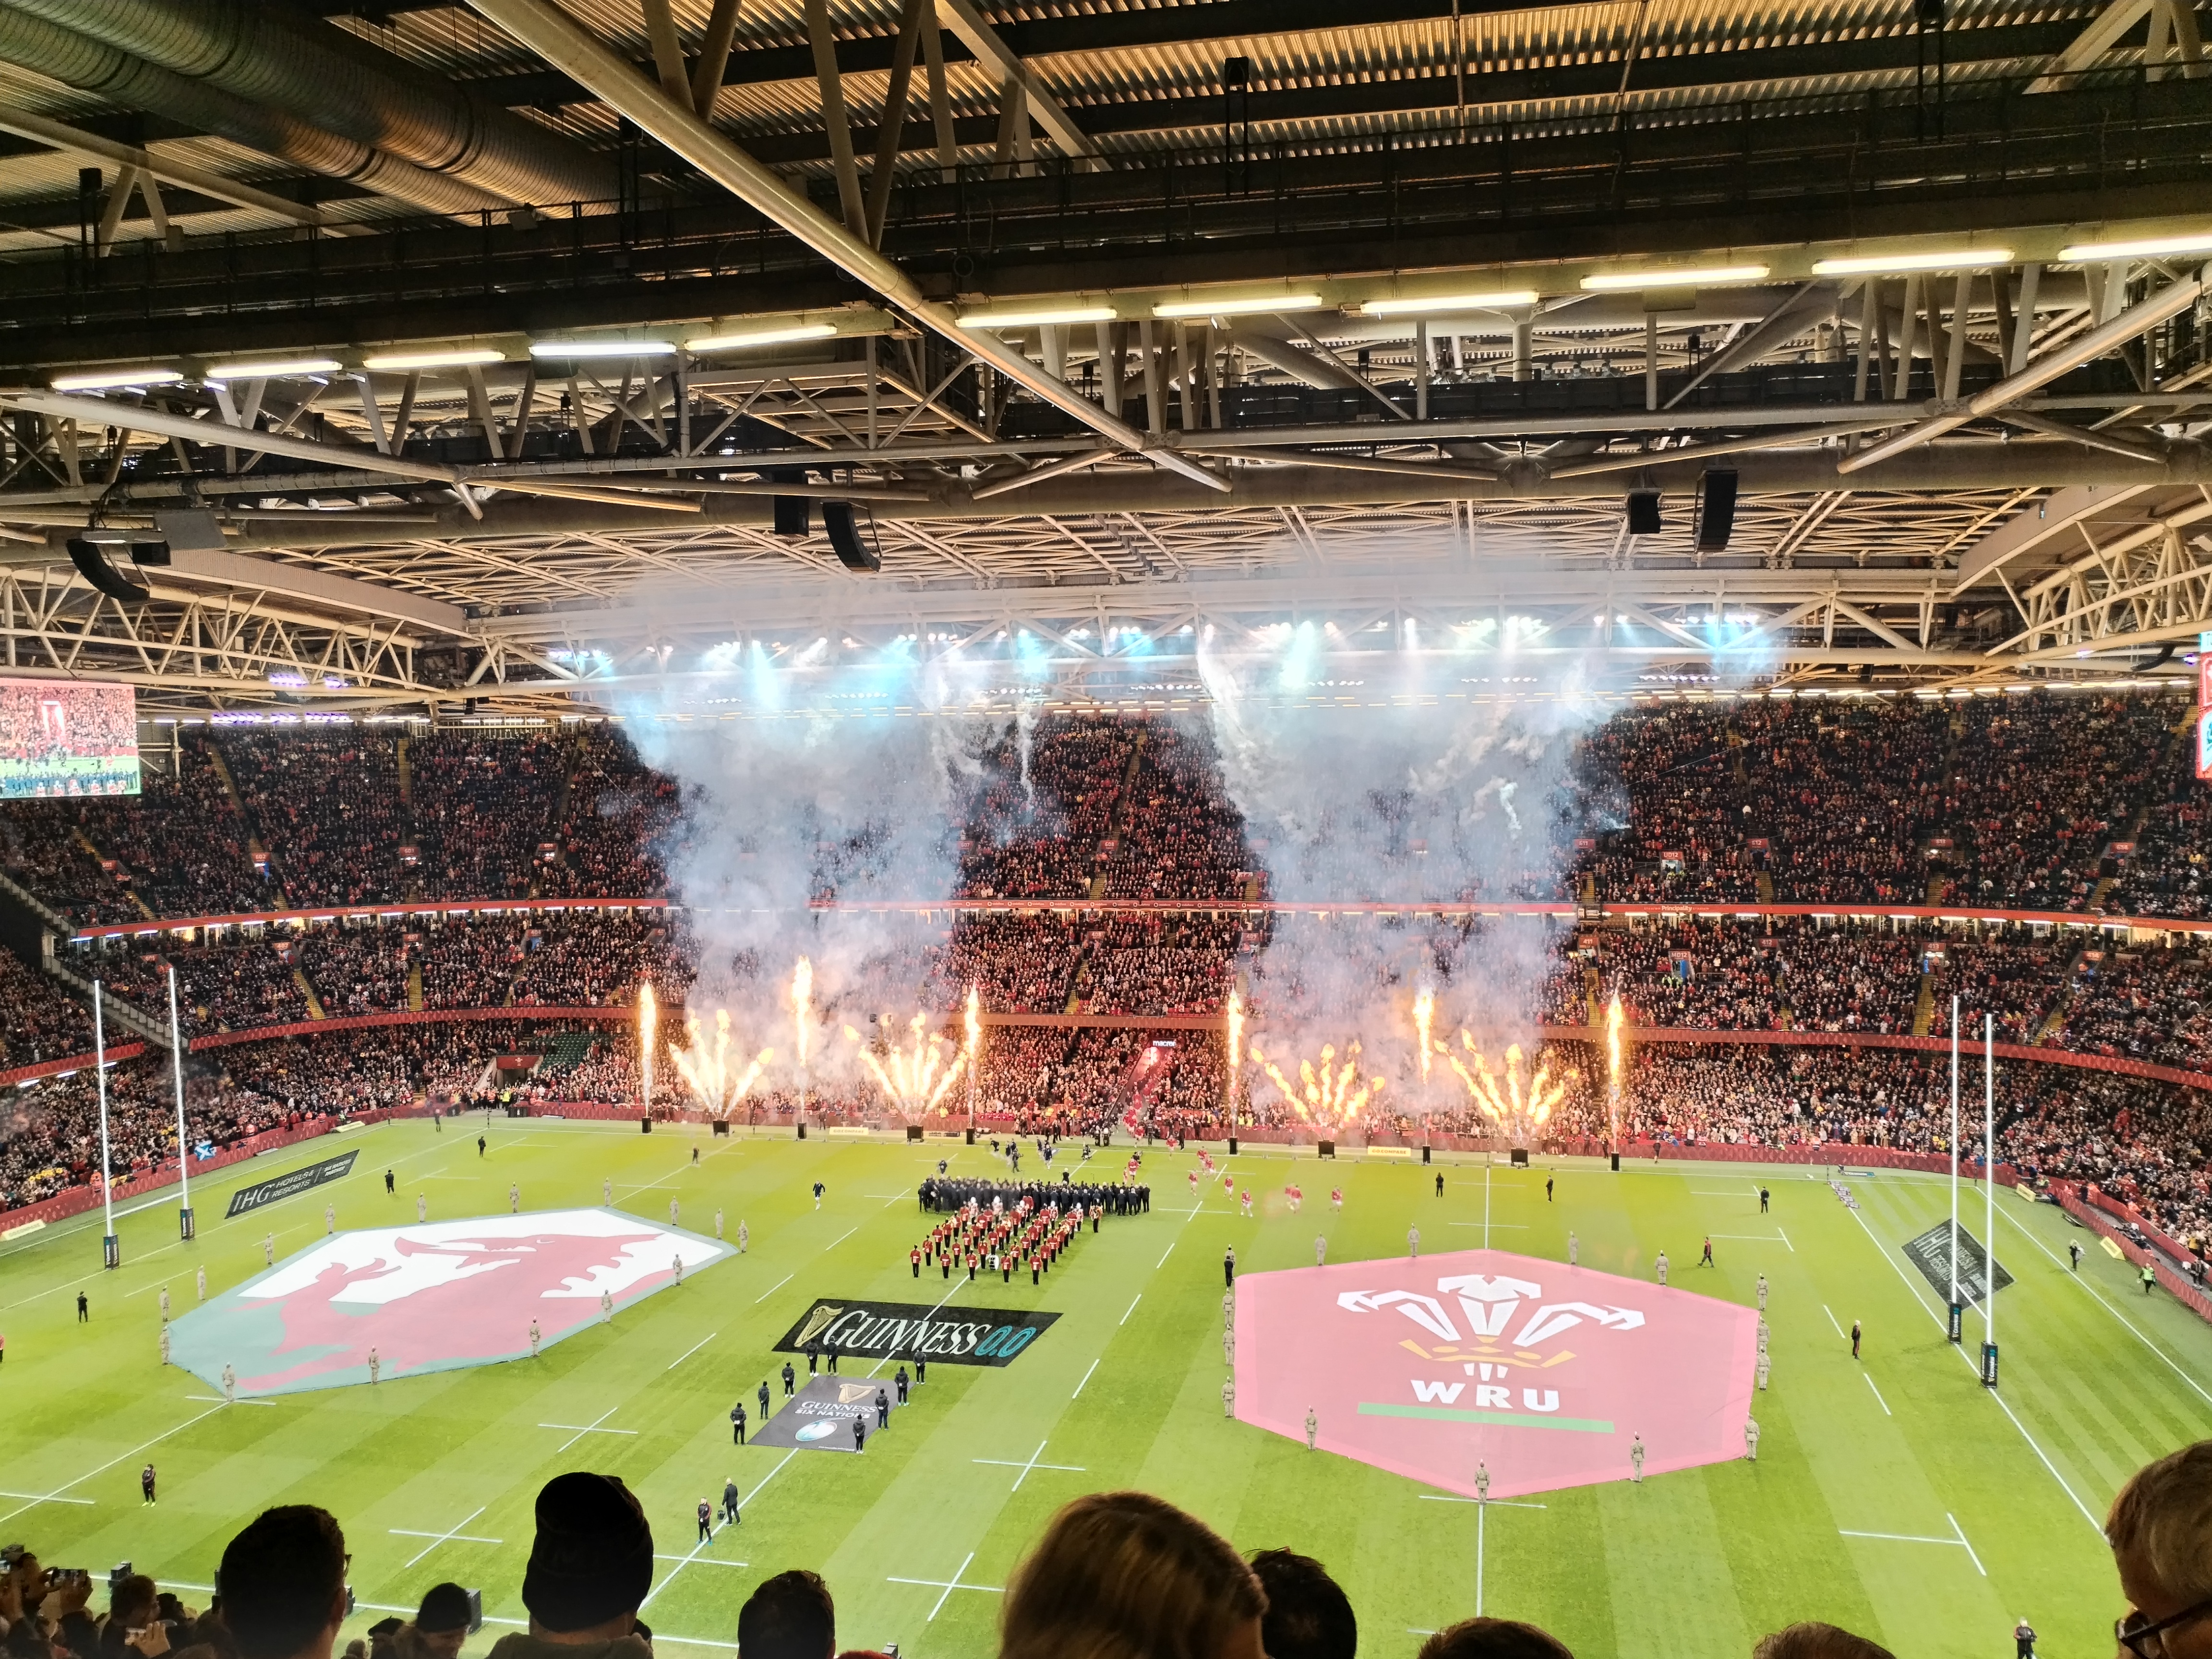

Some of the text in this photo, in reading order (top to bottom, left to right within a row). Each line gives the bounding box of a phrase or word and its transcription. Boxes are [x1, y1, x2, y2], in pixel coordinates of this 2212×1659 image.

[272, 1179, 311, 1198] RESORTS
[276, 1171, 309, 1188] HOTELS
[233, 1184, 272, 1212] IHG
[823, 1310, 1036, 1357] GUINNESS 0.0
[1410, 1379, 1560, 1412] WRU
[801, 1401, 878, 1413] GUINNESS
[817, 1410, 871, 1419] NATIONS
